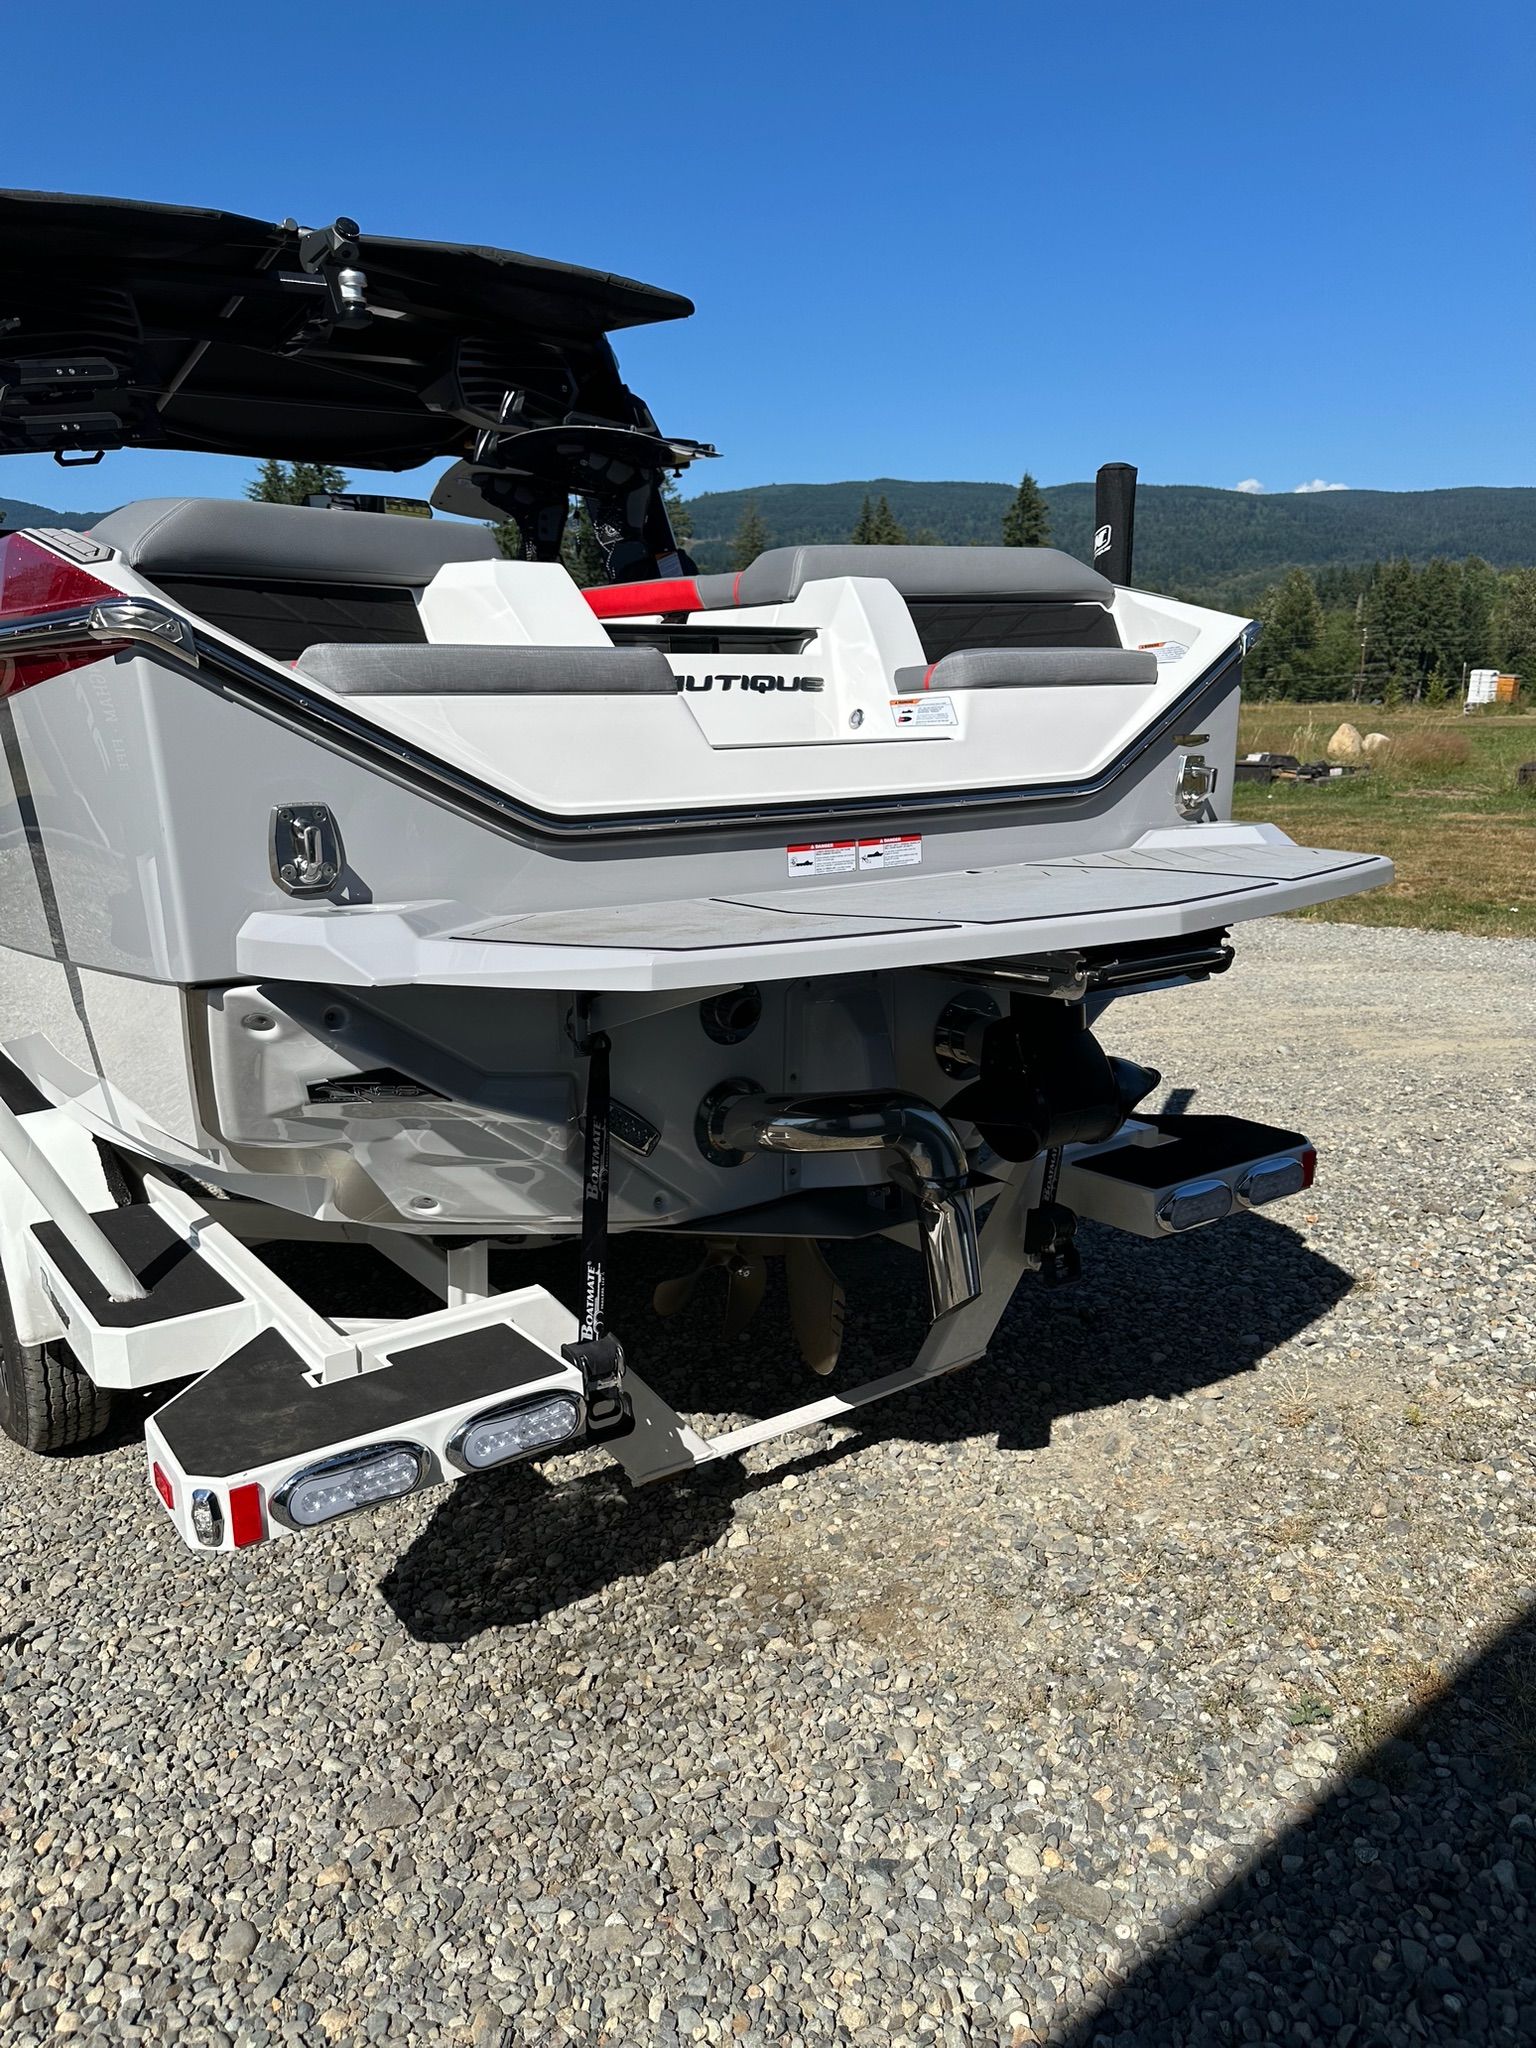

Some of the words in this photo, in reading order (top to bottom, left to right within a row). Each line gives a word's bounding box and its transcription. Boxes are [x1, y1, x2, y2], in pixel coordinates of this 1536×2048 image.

[674, 675, 824, 694] UTIQUE
[585, 1119, 601, 1200] BOATMATE
[580, 1265, 595, 1341] BOATMATE
